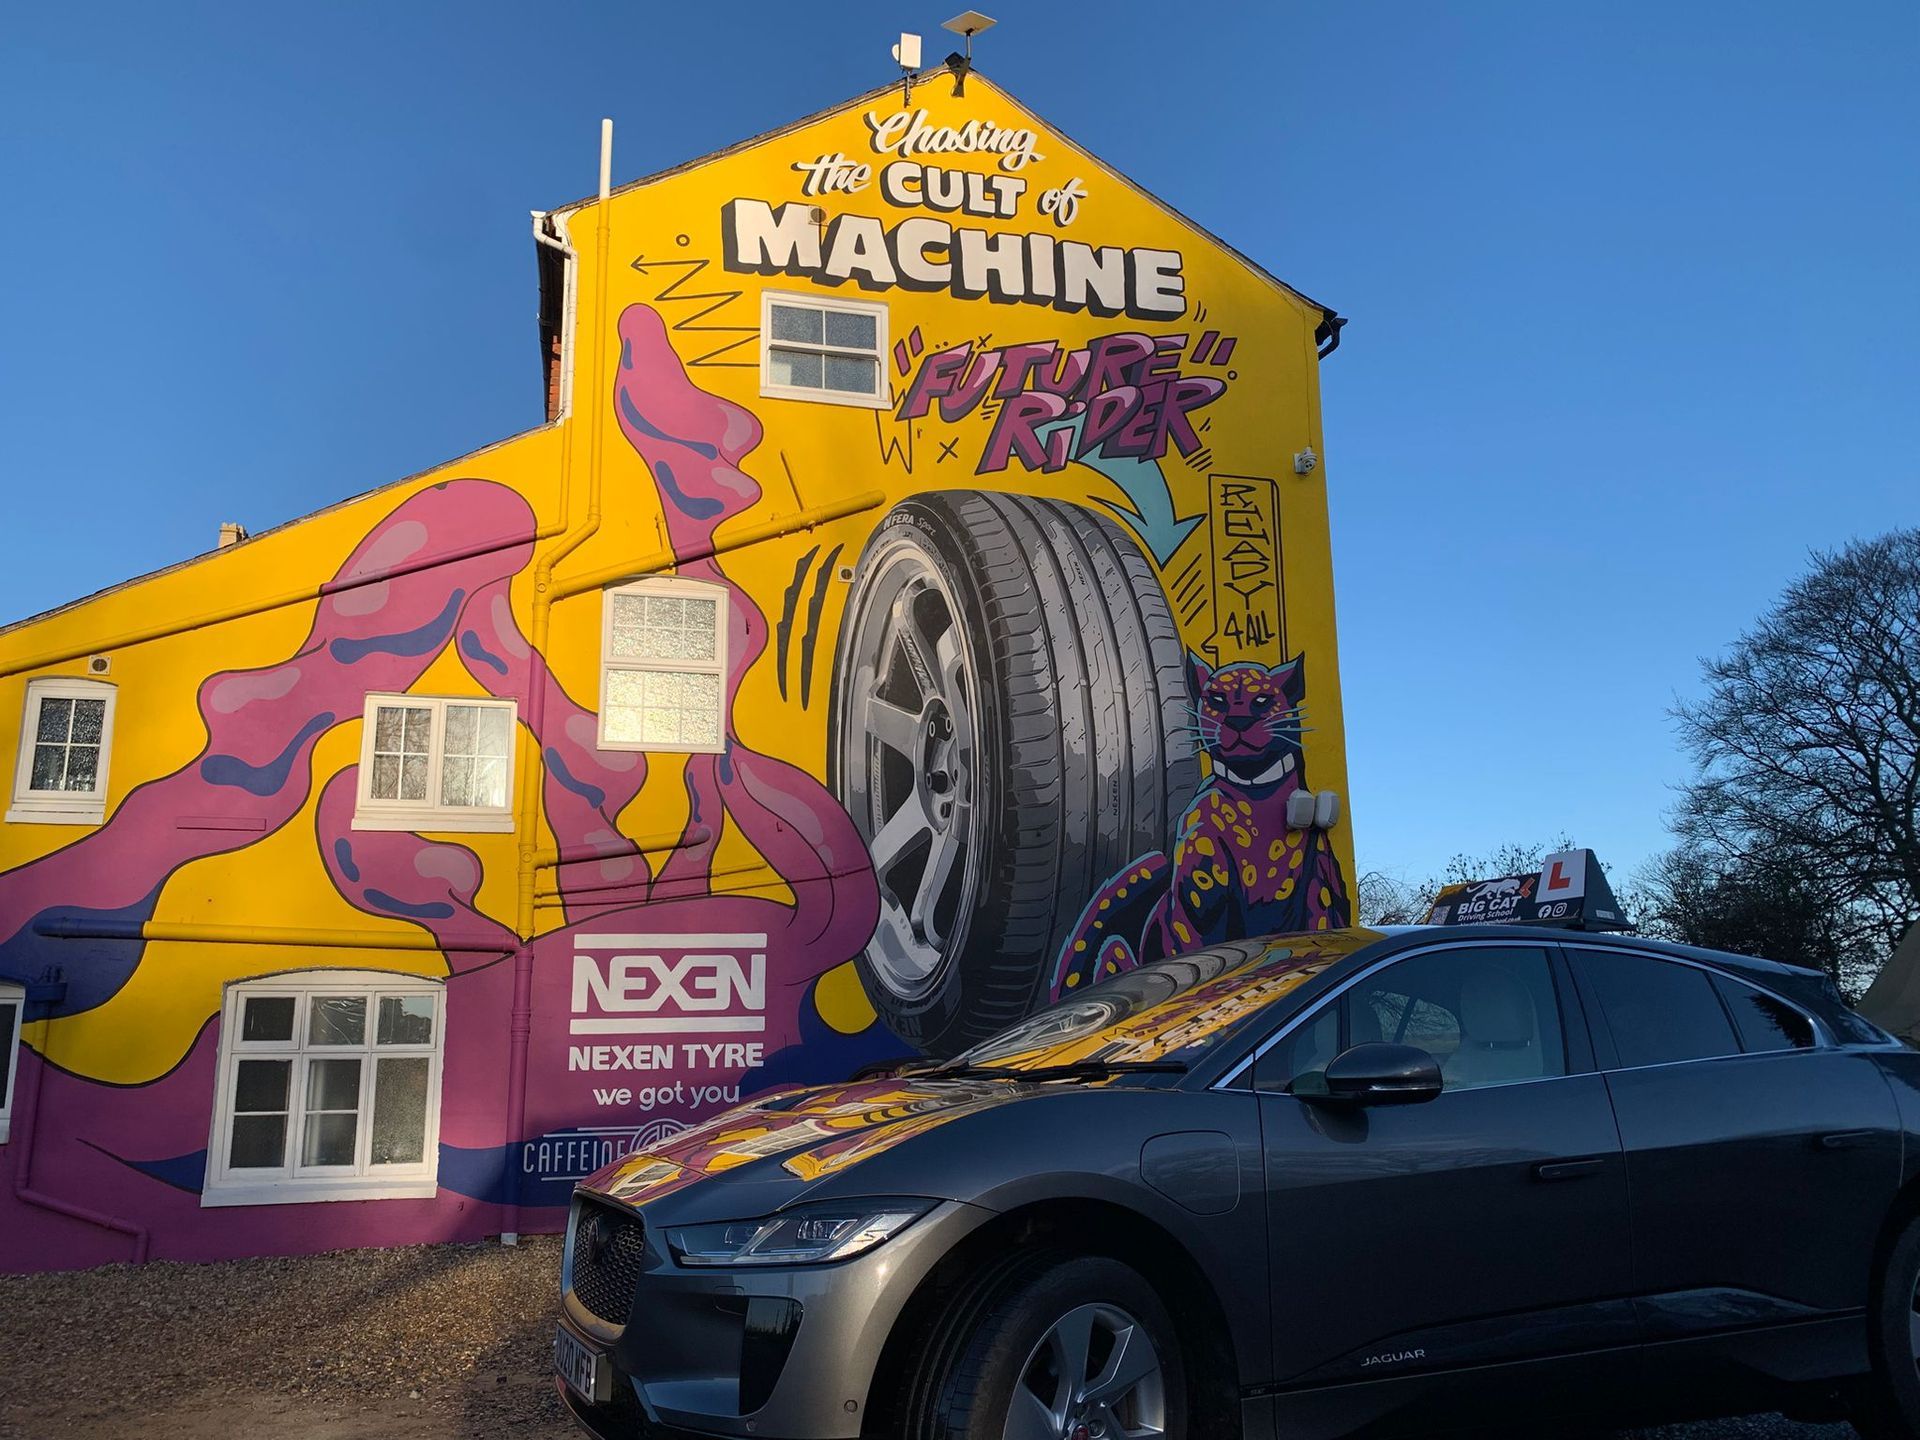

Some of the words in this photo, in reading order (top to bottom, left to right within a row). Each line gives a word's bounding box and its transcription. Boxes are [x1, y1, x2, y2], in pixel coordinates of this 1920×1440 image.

[866, 109, 1045, 172] Chasing
[791, 153, 871, 197] the
[880, 161, 1026, 218] CULT
[1038, 177, 1088, 226] of
[722, 197, 1188, 321] MACHINE
[1220, 483, 1275, 611] READY
[1548, 861, 1571, 890] L
[1457, 900, 1487, 915] BIG
[1489, 896, 1522, 911] CAT
[1458, 912, 1486, 922] Driving
[1487, 908, 1513, 919] School
[571, 954, 766, 1012] NEXEN
[568, 1044, 673, 1071] NEXEN
[682, 1043, 764, 1068] TYRE
[593, 1088, 632, 1106] we
[639, 1081, 685, 1111] got
[690, 1084, 740, 1109] you
[1361, 1349, 1425, 1366] JAGUAR
